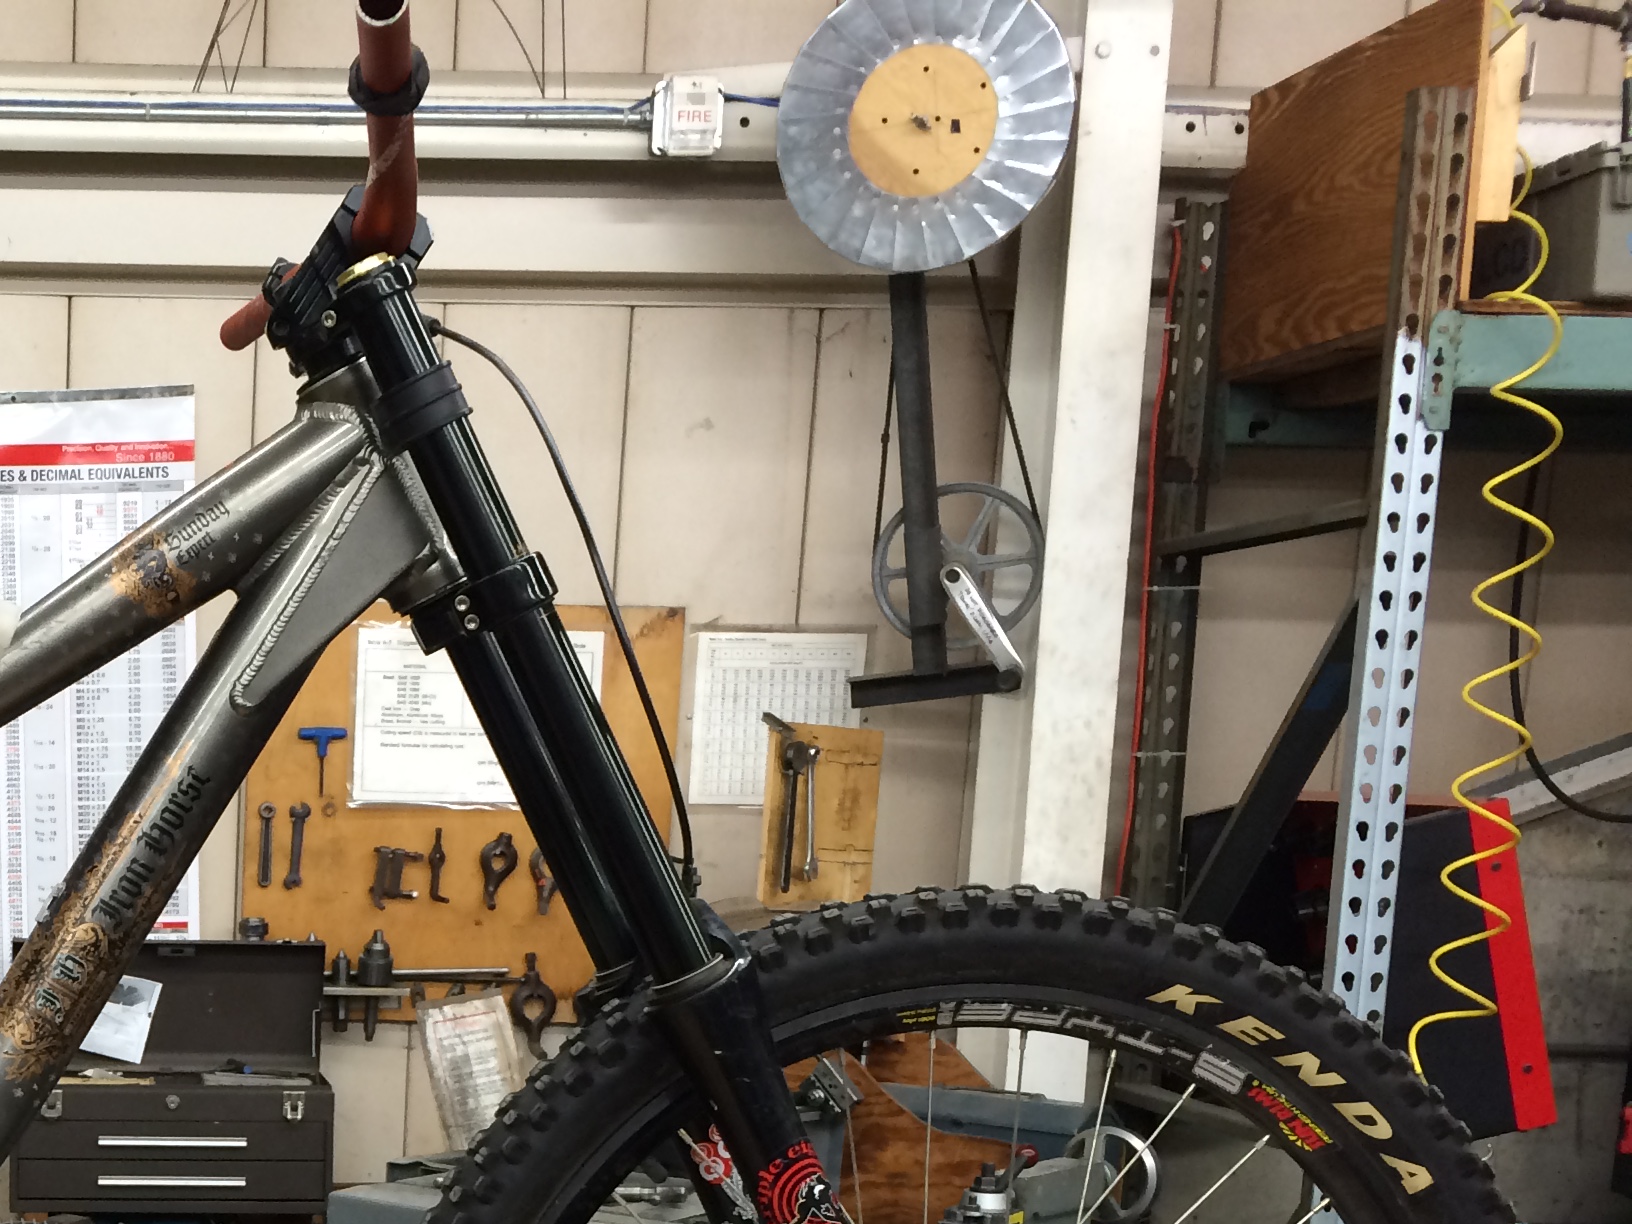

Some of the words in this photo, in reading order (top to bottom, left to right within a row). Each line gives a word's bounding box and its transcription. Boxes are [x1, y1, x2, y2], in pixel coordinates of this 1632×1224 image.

[678, 110, 712, 123] FIRE
[115, 452, 145, 463] Since
[149, 451, 175, 462] 1880
[18, 469, 27, 482] &
[30, 468, 85, 481] DECIMAL
[88, 466, 170, 480] EQUIVALENTS
[164, 501, 230, 552] Sunday
[91, 857, 156, 931] Iron
[136, 764, 211, 857] Horse
[1145, 983, 1434, 1196] KENDA
